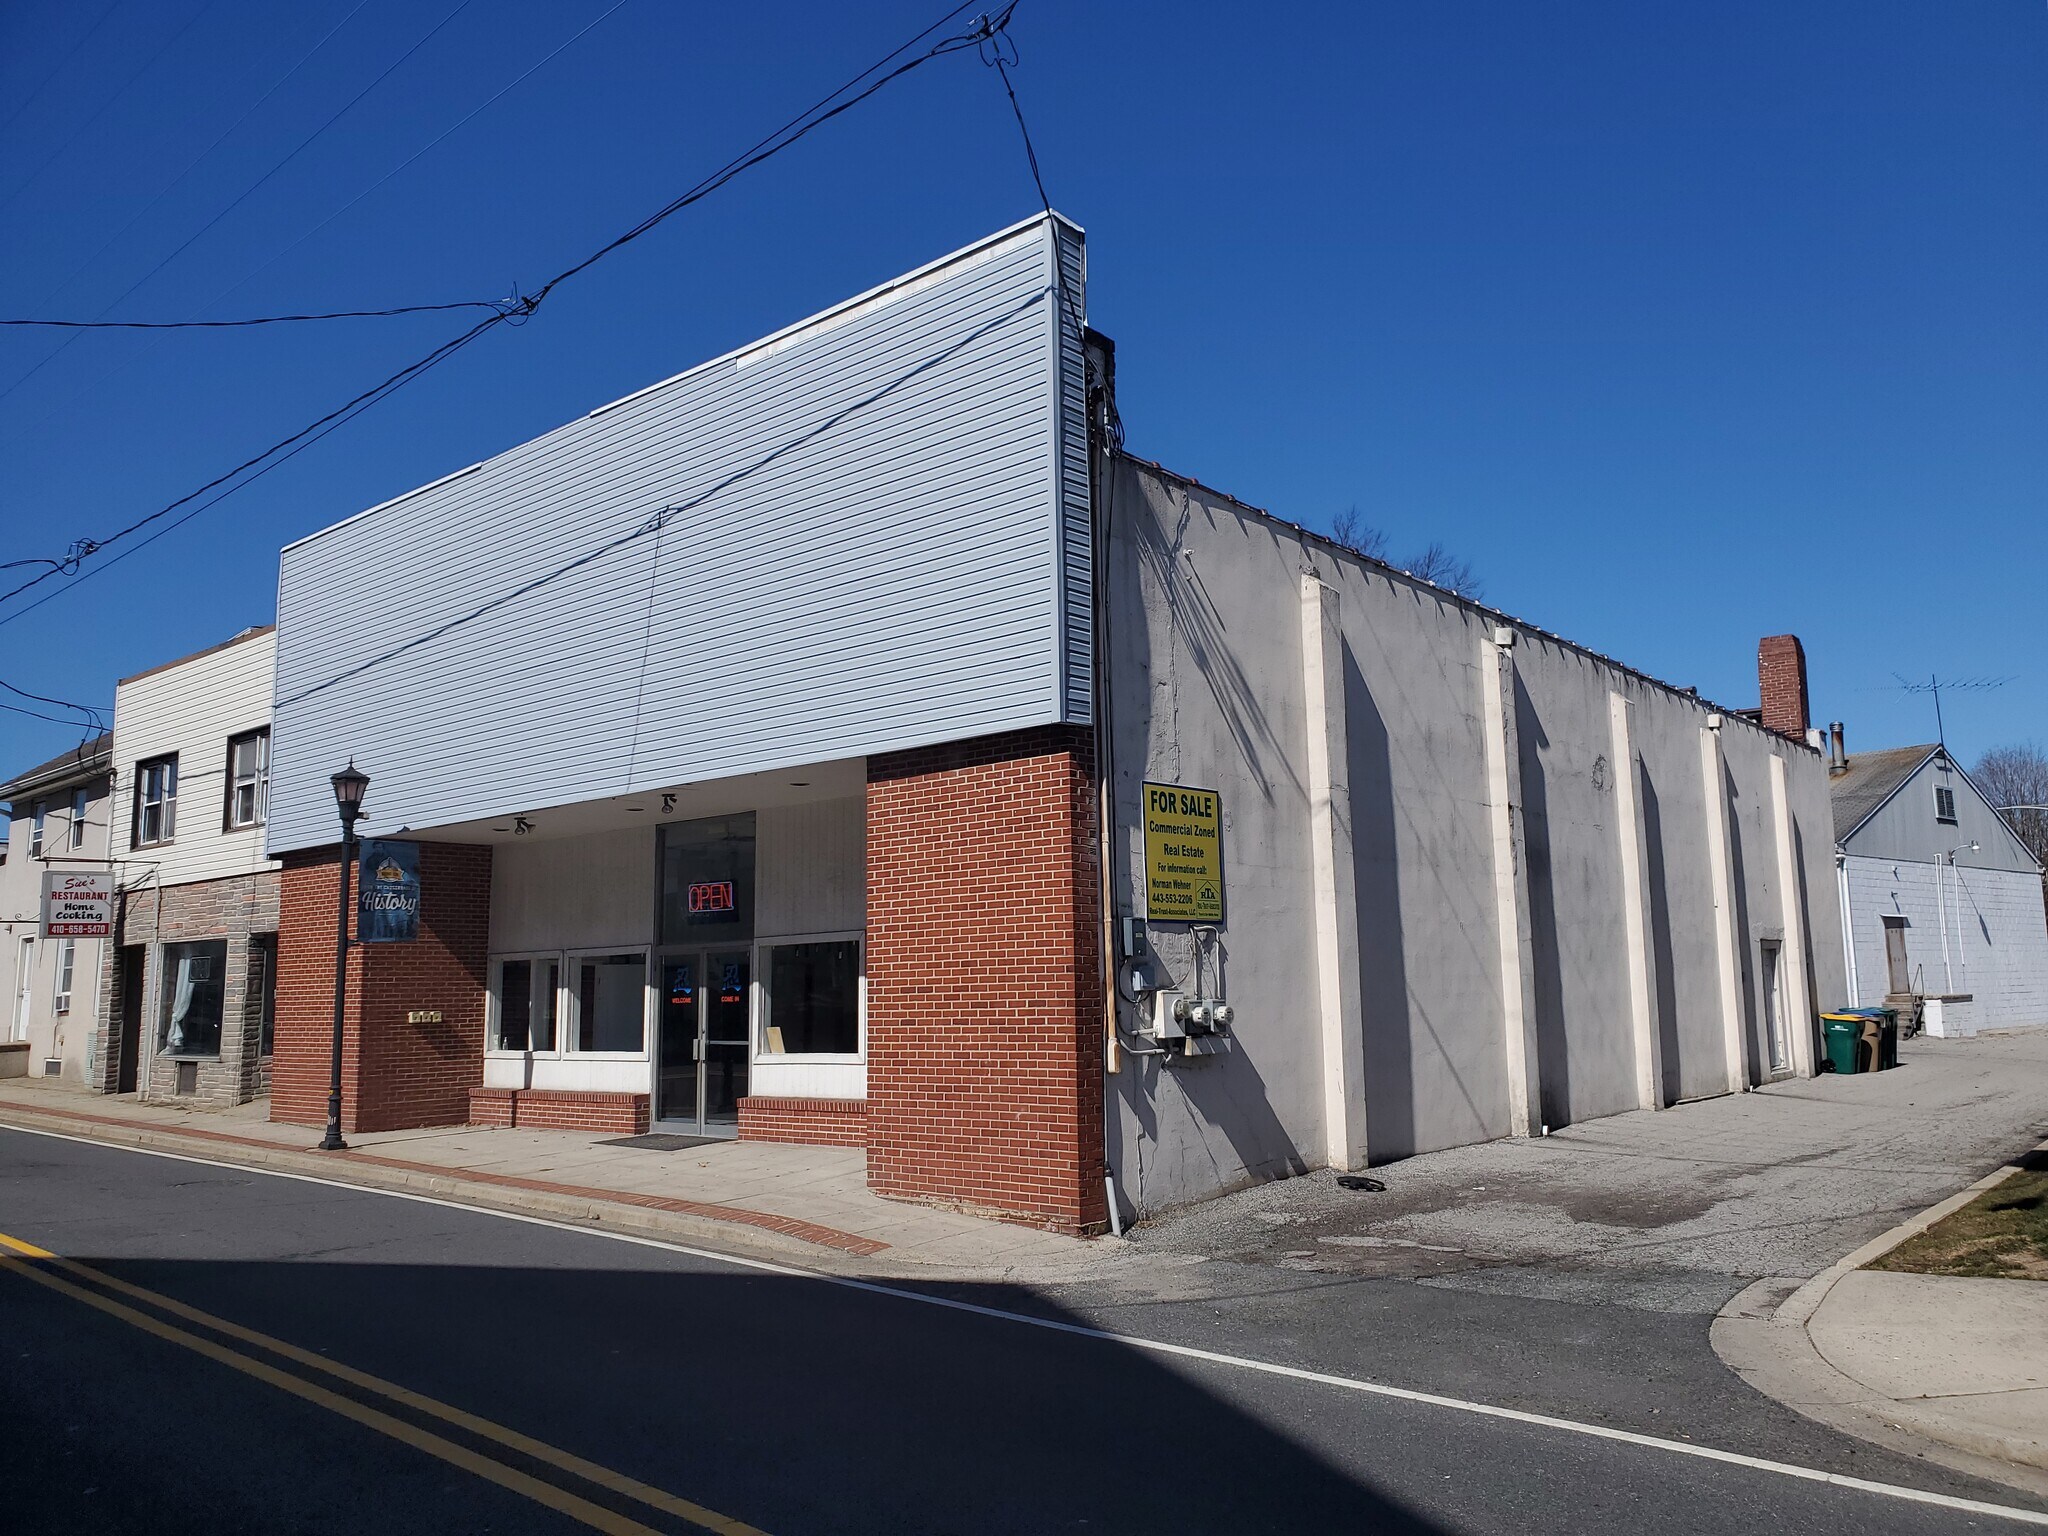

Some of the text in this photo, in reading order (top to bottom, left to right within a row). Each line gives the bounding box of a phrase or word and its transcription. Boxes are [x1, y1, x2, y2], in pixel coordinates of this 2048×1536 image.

[1150, 790, 1212, 818] FOR SALE
[1149, 820, 1215, 838] Commercial Zoned
[1163, 843, 1204, 859] Real Estate
[1158, 862, 1207, 875] For information call:
[64, 875, 96, 890] Sue's
[1152, 878, 1172, 889] Norman
[51, 891, 109, 900] RESTAURANT
[689, 884, 731, 911] OPEN
[1200, 888, 1216, 900] RTA
[64, 903, 95, 911] Home
[362, 891, 417, 916] History
[56, 911, 103, 922] Cooking
[51, 925, 106, 934] 410-658-5470
